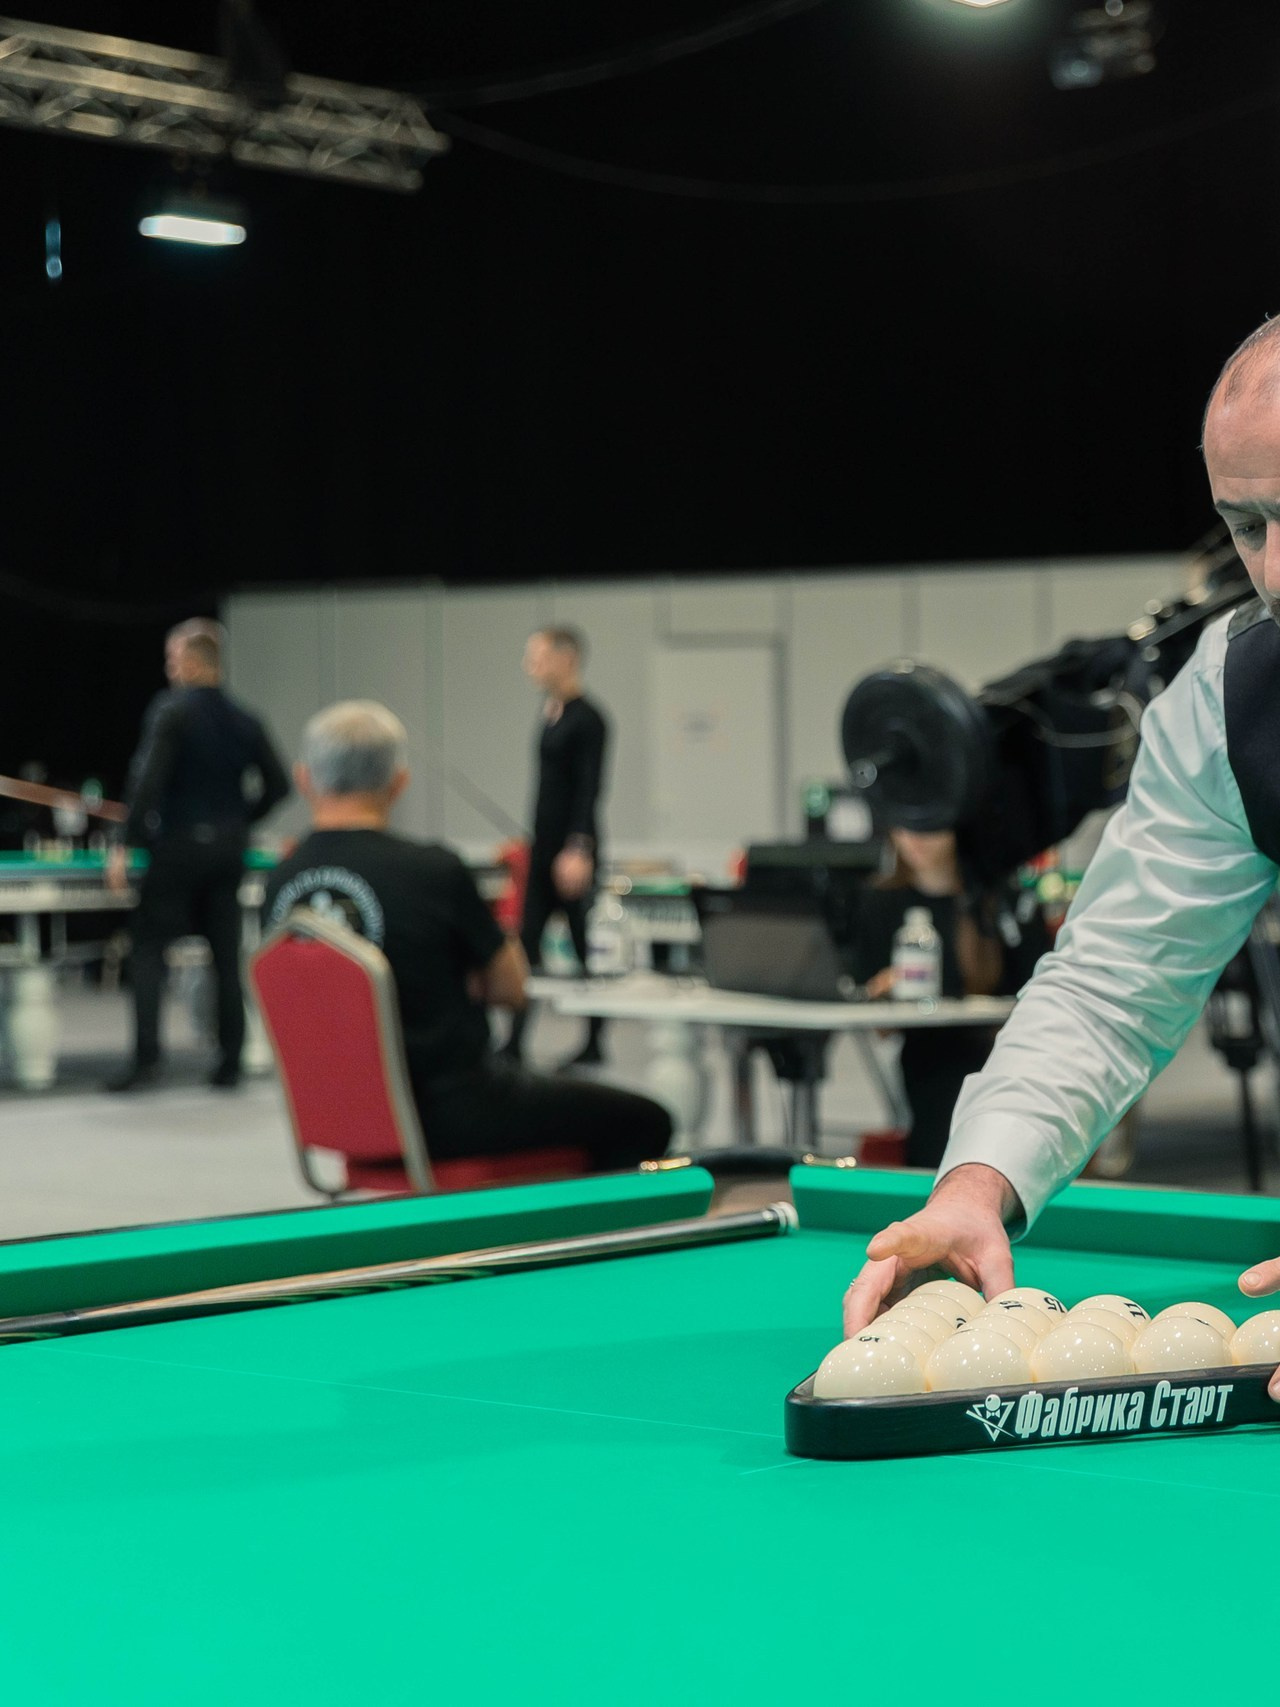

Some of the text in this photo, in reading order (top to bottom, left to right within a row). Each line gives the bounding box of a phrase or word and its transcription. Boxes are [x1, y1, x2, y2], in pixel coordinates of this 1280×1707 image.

[1043, 1296, 1066, 1314] 15
[1123, 1302, 1147, 1320] 11
[1015, 1380, 1234, 1439] Фабрика Старт
